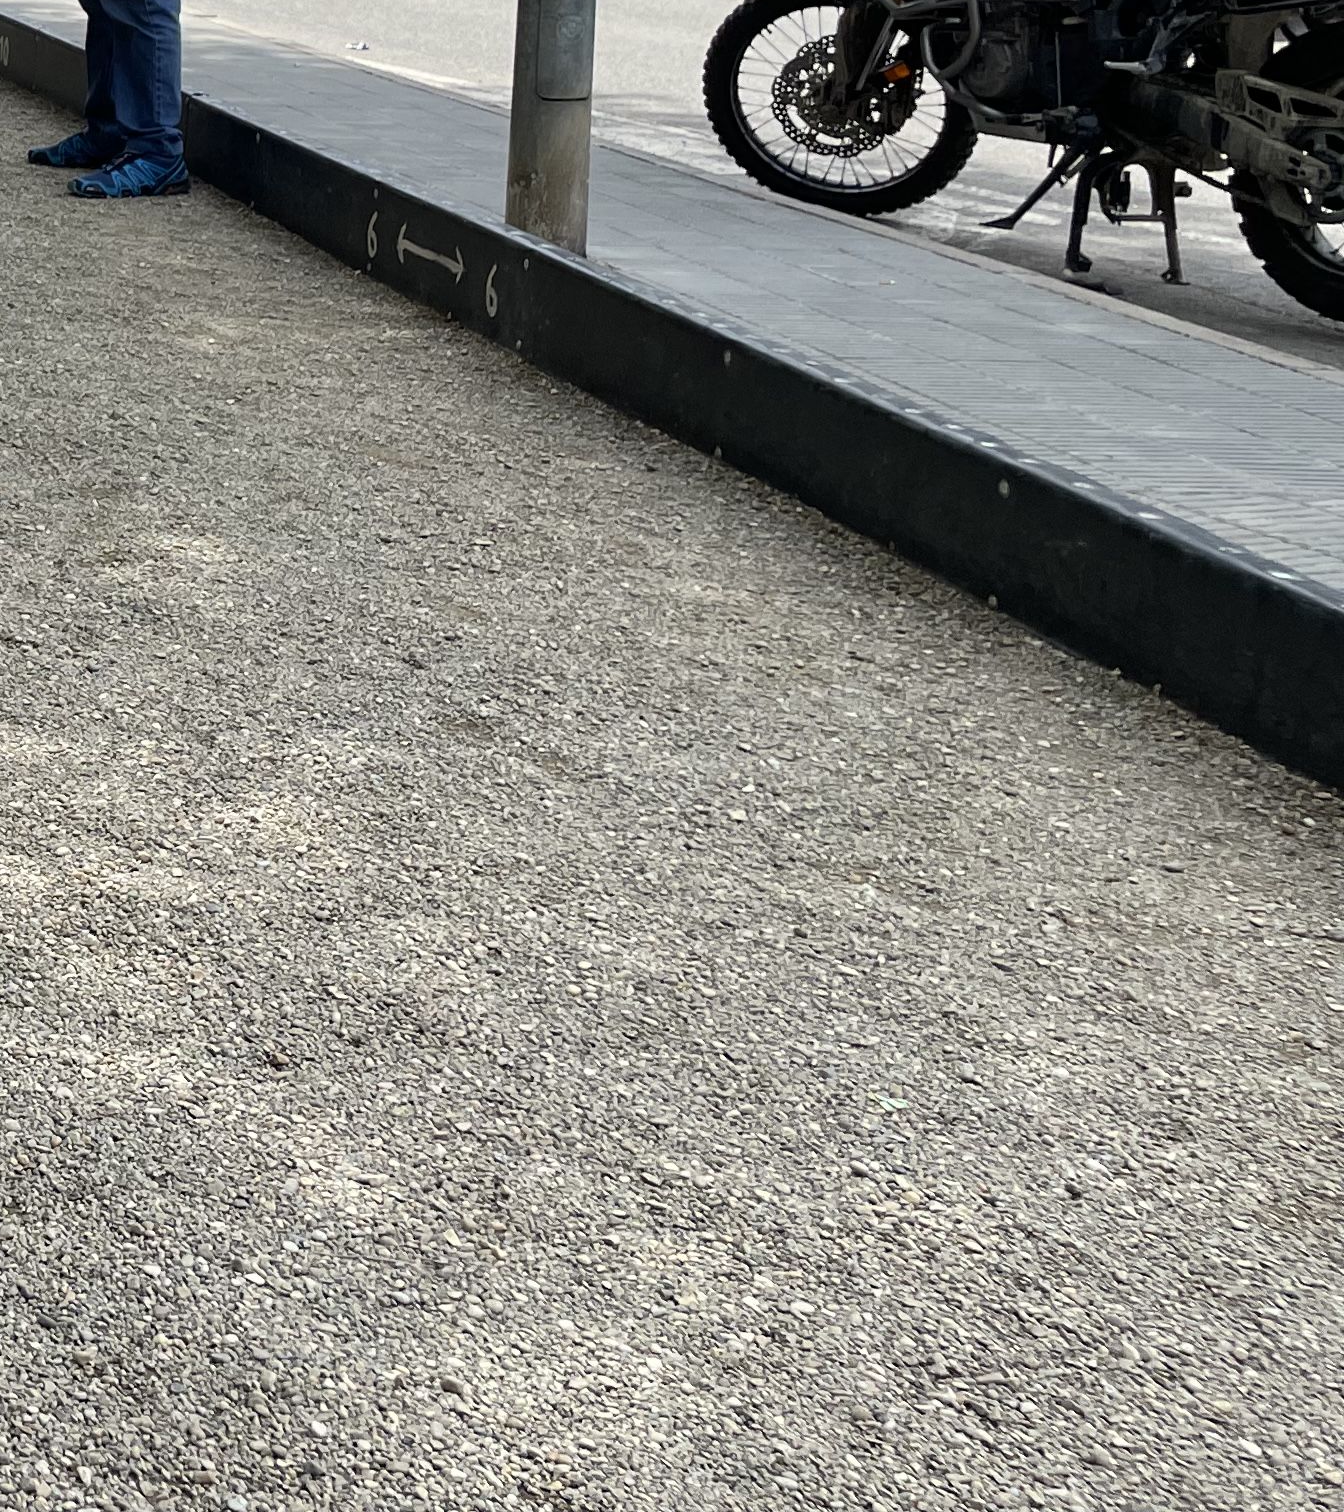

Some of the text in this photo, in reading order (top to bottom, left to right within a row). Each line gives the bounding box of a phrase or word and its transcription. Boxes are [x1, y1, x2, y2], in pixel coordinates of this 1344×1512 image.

[0, 35, 10, 67] 10
[367, 210, 498, 318] 6 6
